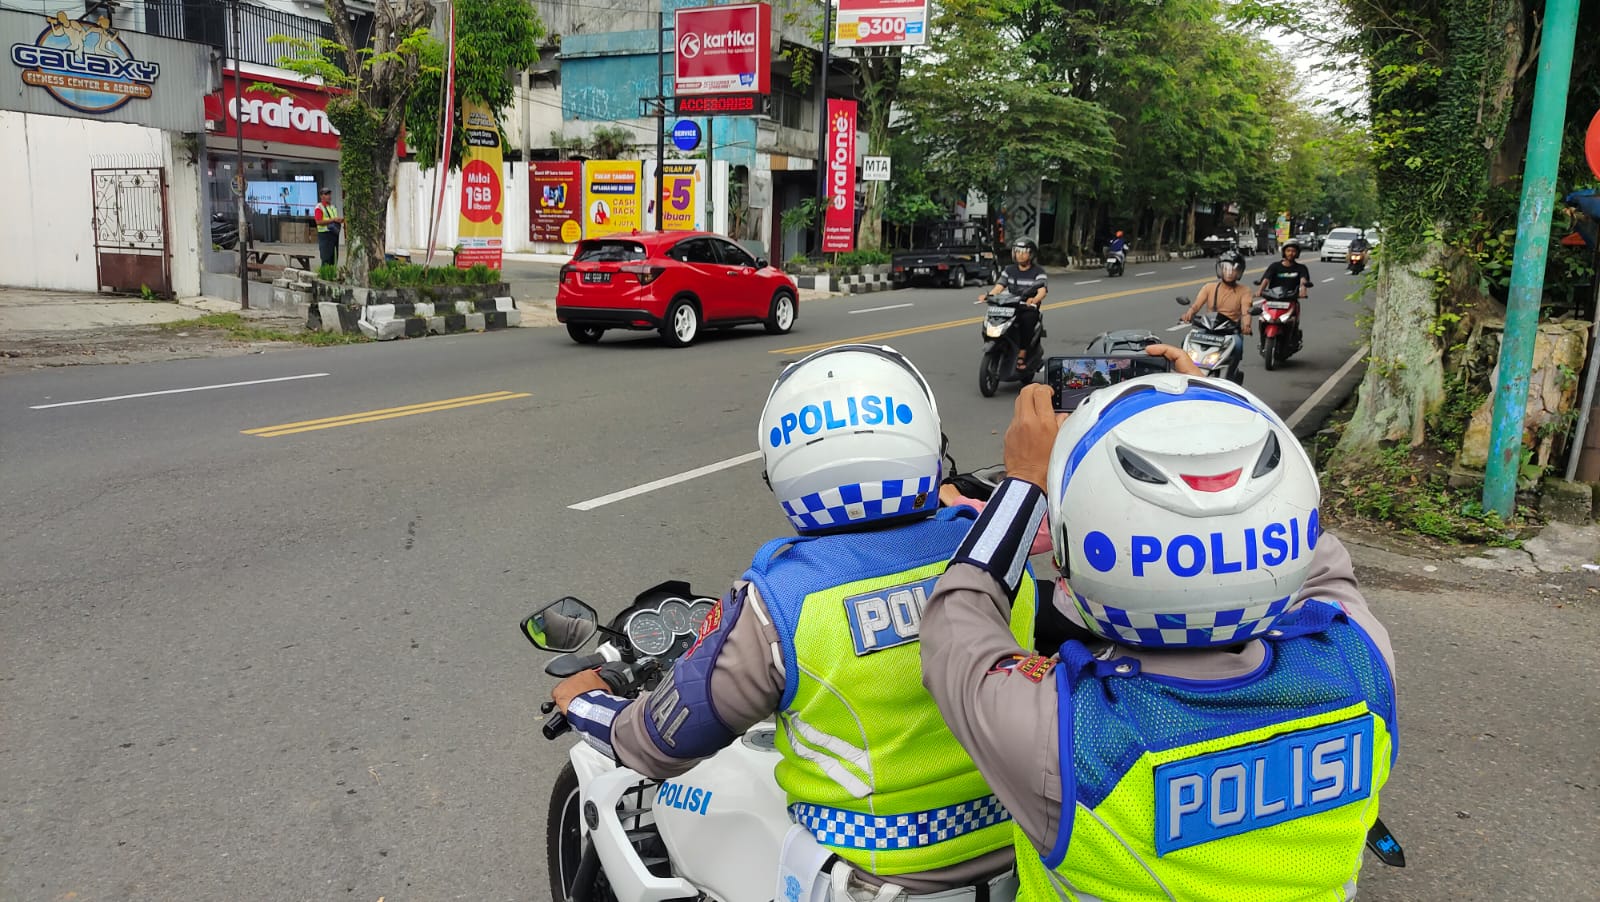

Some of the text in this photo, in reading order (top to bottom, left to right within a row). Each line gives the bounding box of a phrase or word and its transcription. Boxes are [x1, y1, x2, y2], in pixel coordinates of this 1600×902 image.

[871, 18, 905, 34] 300
[703, 30, 755, 49] kartika
[27, 72, 148, 96] FITNESS CENTER & AEROBIC
[831, 116, 848, 210] erafone
[865, 160, 888, 172] MTA
[612, 199, 636, 207] CASH
[672, 178, 691, 211] 5
[613, 207, 636, 215] BACK
[663, 211, 691, 221] ibuan
[780, 395, 894, 445] POLISI
[1131, 518, 1300, 578] POLISI
[657, 781, 713, 816] POLISI
[1169, 733, 1362, 840] POLISI
